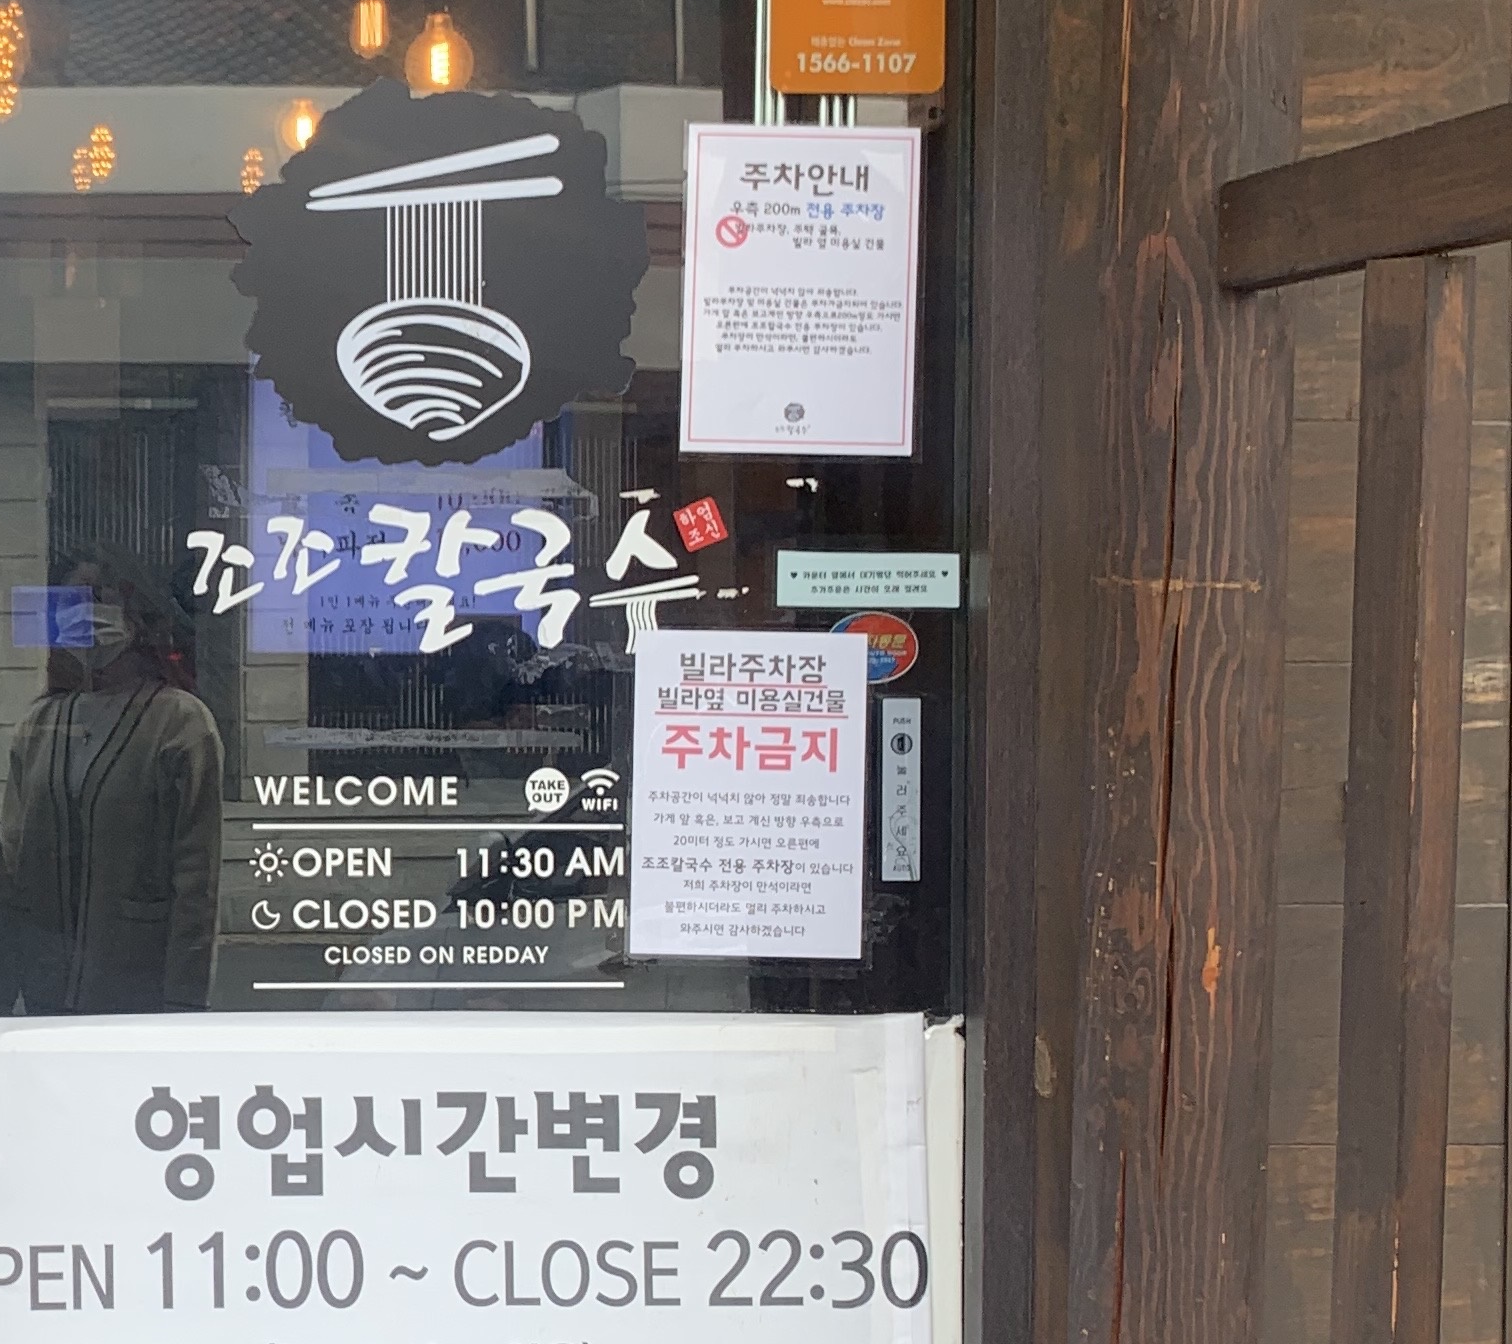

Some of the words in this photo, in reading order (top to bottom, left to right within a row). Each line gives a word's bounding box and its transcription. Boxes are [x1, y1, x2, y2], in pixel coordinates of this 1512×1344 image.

[796, 52, 917, 74] 1566-1107
[739, 162, 870, 197] 주차안내
[730, 201, 759, 217] 우측
[763, 203, 801, 216] 200m
[806, 202, 835, 220] 전용
[840, 202, 885, 221] 주차장
[187, 503, 700, 654] 조조칼국수
[680, 653, 826, 684] 빌라주차장
[658, 687, 724, 711] 빌라옆
[737, 688, 846, 713] 미용실건물
[662, 725, 838, 772] 주차금지
[254, 775, 459, 806] WELCOME
[529, 780, 566, 791] TAKE
[532, 792, 564, 804] OUT
[581, 798, 619, 811] WIFI
[648, 791, 703, 804] 주차공간이
[707, 792, 740, 805] 넉넉치
[743, 792, 766, 805] 않아
[769, 793, 792, 806] 정말
[795, 793, 851, 806] 죄송합니다
[653, 813, 675, 824] 가게
[723, 815, 744, 825] 보고
[748, 815, 770, 827] 계신
[800, 816, 844, 828] 우측으로
[673, 835, 709, 847] 20미터
[713, 836, 735, 848] 정도
[739, 836, 772, 849] 가시면
[775, 837, 820, 849] 오른편에
[292, 847, 392, 878] OPEN
[456, 847, 555, 878] 11:30
[564, 846, 624, 877] AM
[641, 856, 713, 873] 조조칼국수
[718, 857, 746, 874] 전용
[751, 858, 806, 875] 주차장이
[809, 862, 854, 875] 있습니다
[683, 879, 705, 891] 저희
[708, 880, 752, 893] 주차장이
[292, 899, 437, 929] CLOSED
[456, 898, 555, 929] 10:00
[568, 898, 625, 929] PM
[664, 900, 741, 914] 불편하시더라도
[745, 901, 767, 915] 멀리
[771, 902, 826, 915] 주차하시고
[680, 922, 724, 935] 와주시면
[728, 923, 806, 938] 감사하겠습니다
[324, 946, 411, 965] CLOSED
[419, 946, 454, 965] ON
[463, 946, 549, 964] REDDAY
[135, 1083, 720, 1201] 영업시간변경
[147, 1229, 365, 1312] 11:00
[453, 1238, 680, 1308] CLOSE
[706, 1229, 930, 1312] 22:30
